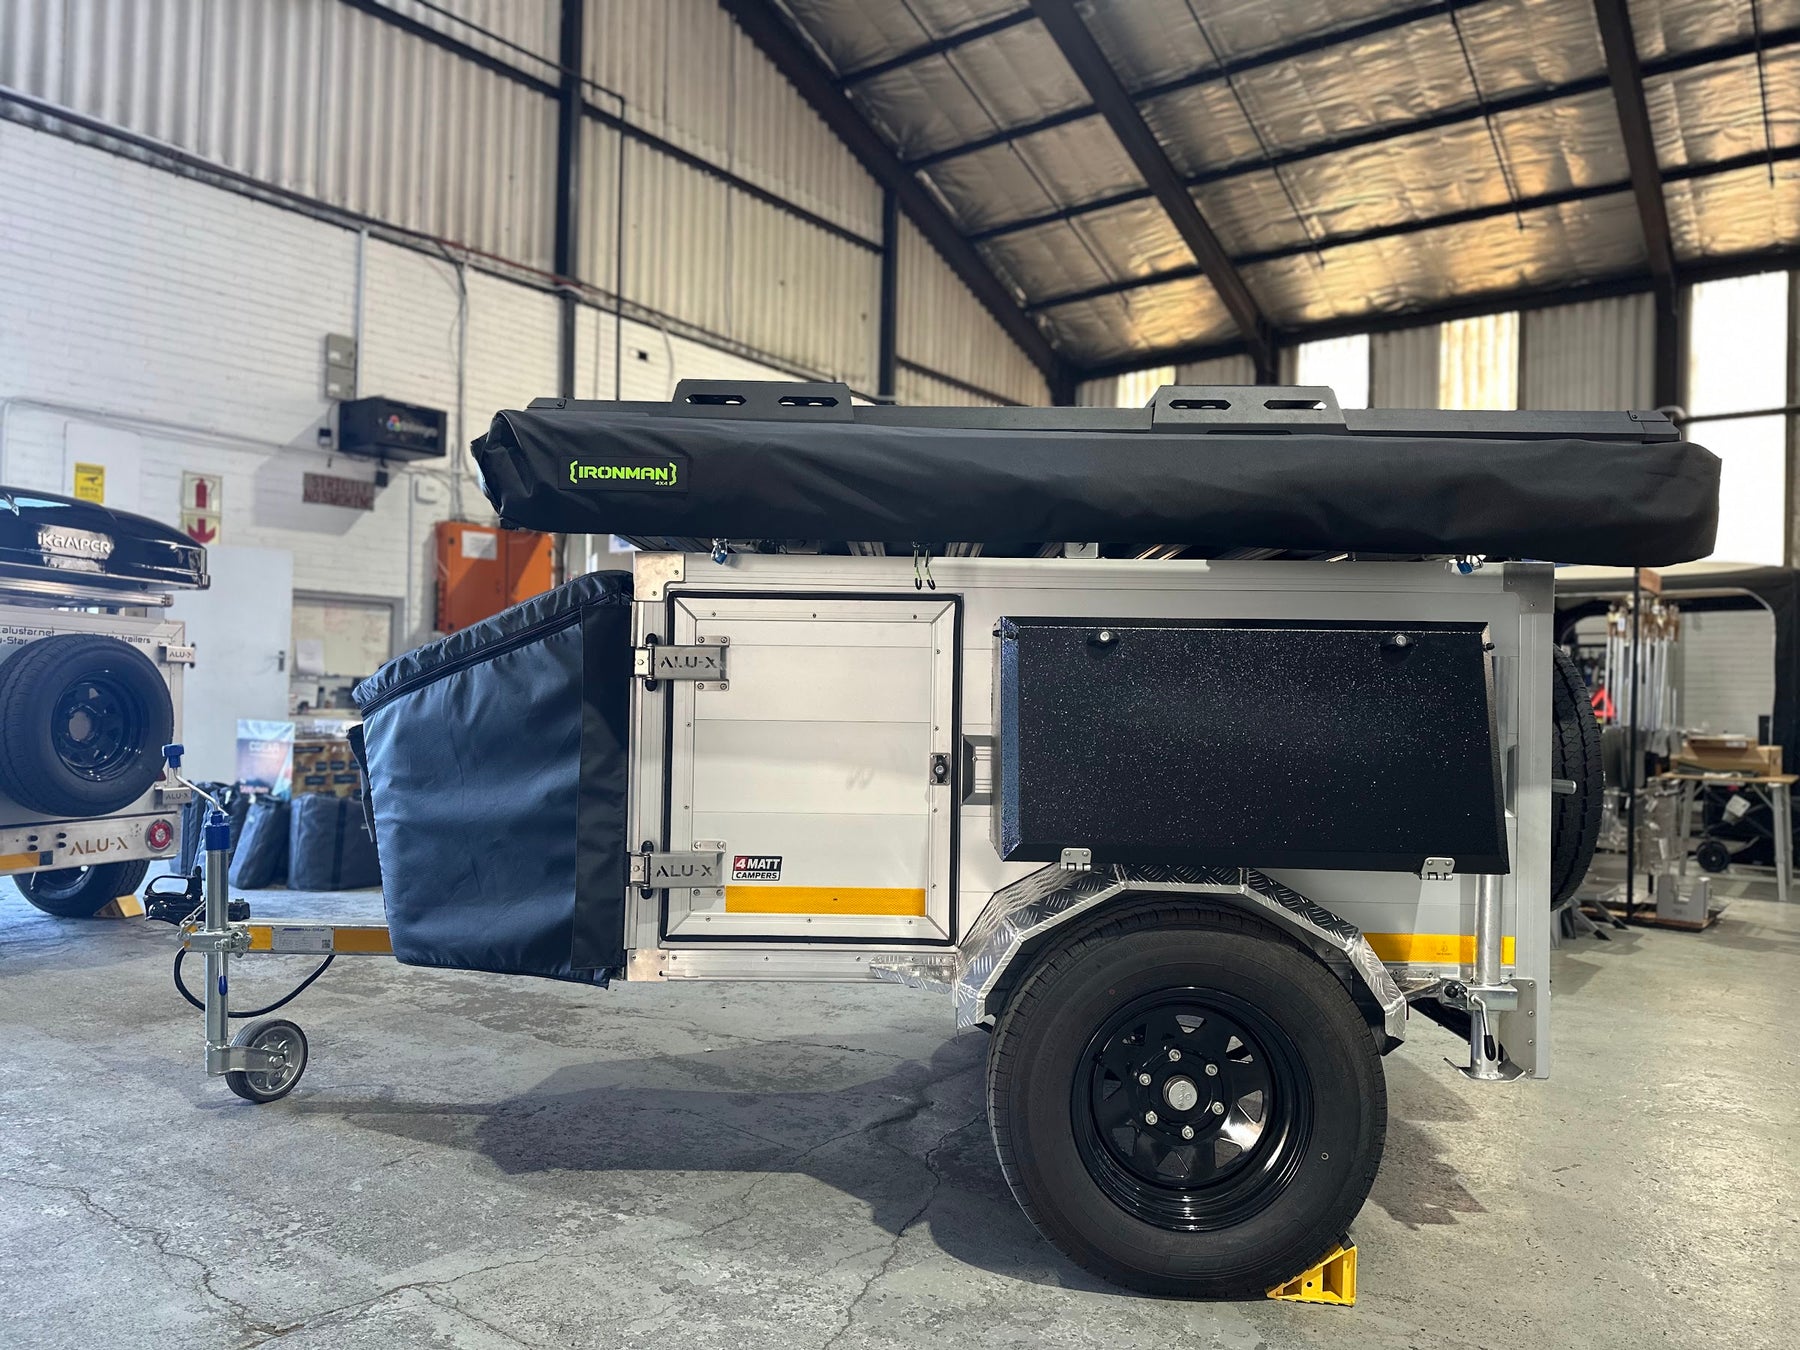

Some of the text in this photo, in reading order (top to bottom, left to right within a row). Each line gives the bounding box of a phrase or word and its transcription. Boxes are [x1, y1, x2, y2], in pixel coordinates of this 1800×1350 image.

[578, 466, 669, 480] IRONMAN
[660, 656, 718, 669] ALU-X
[165, 792, 188, 800] ALU-X
[69, 836, 128, 856] ALU-X
[656, 864, 713, 878] ALU-X
[735, 871, 778, 879] CAMPERS
